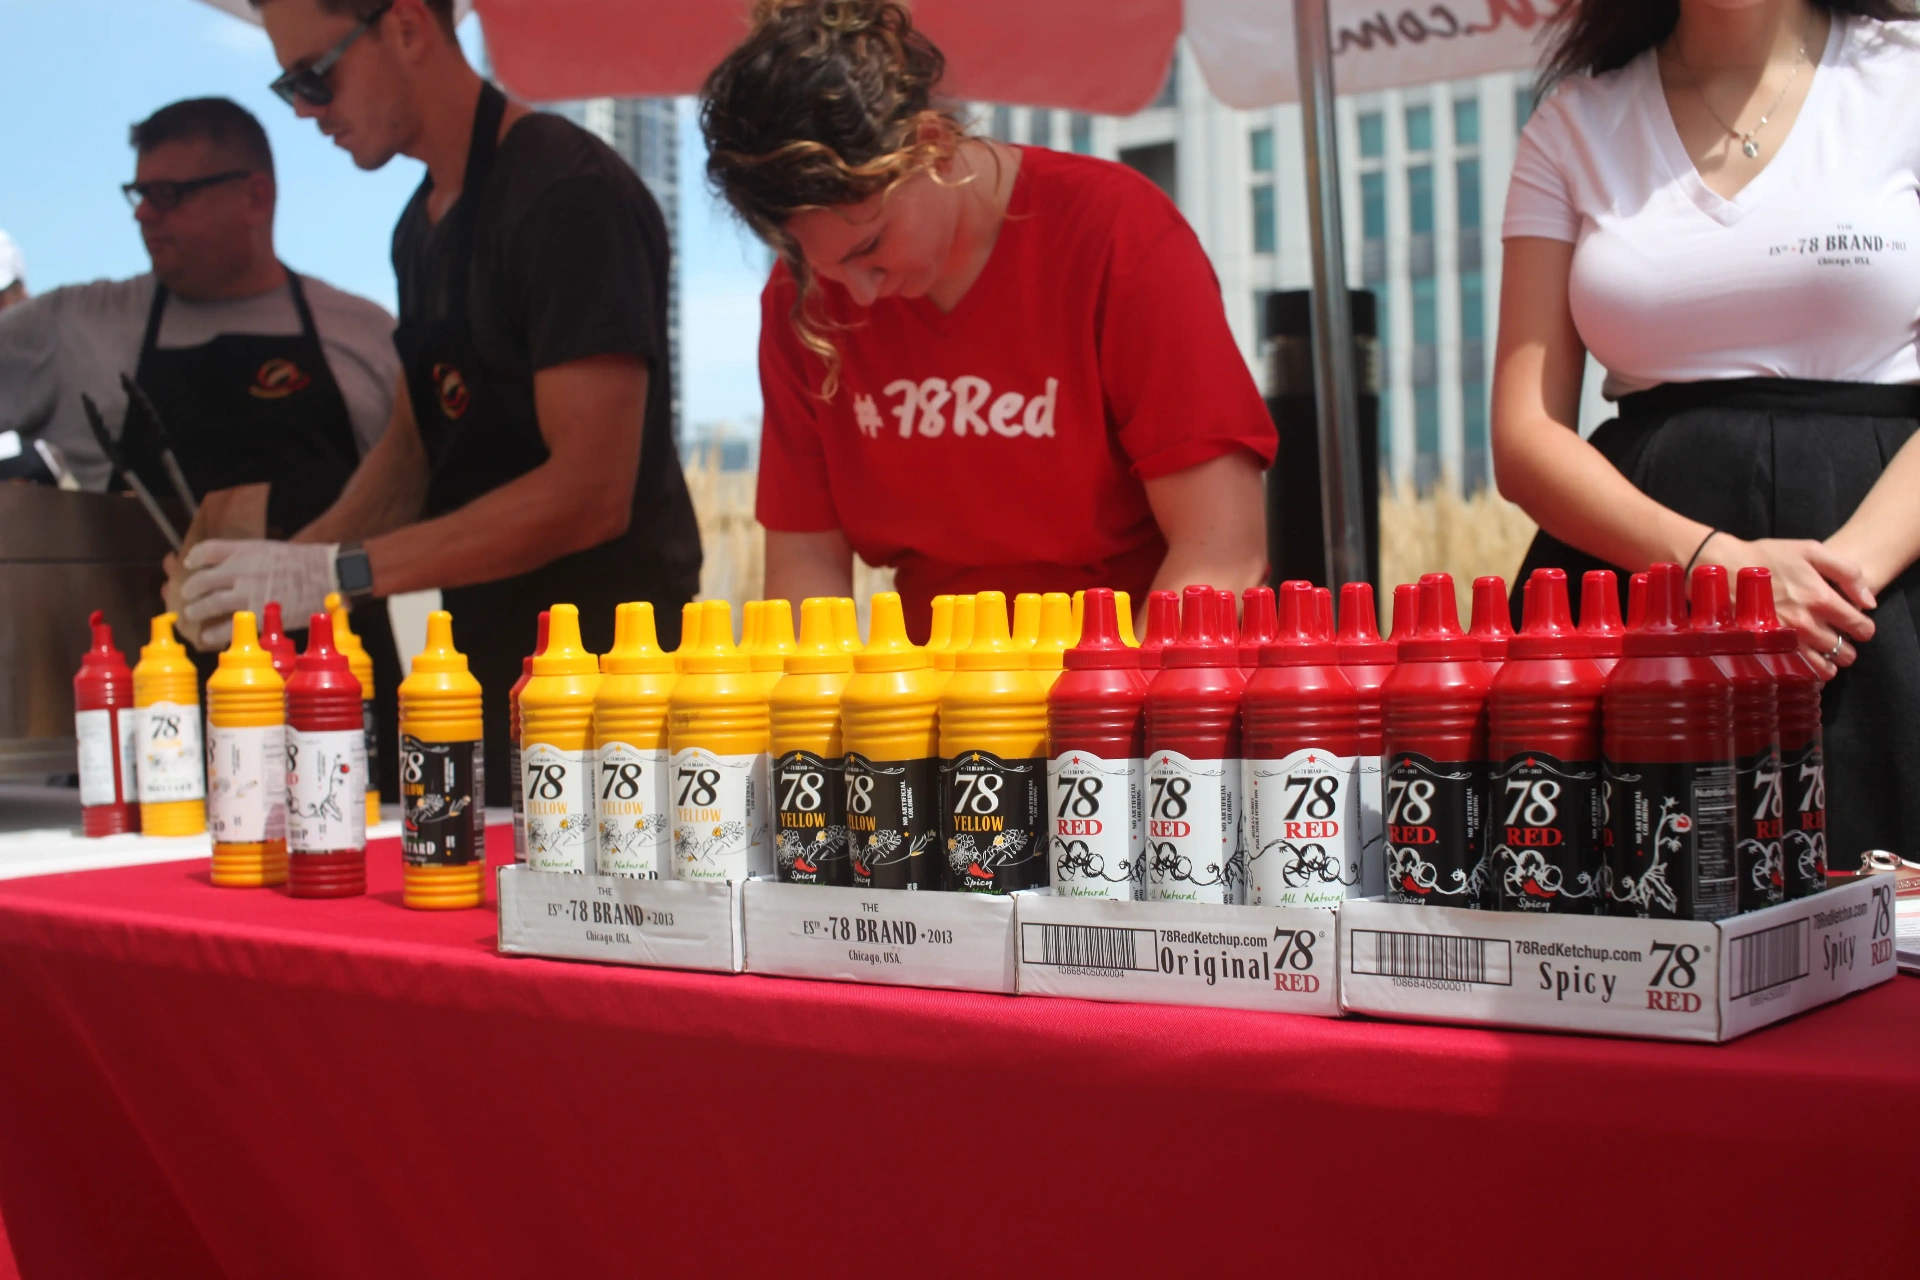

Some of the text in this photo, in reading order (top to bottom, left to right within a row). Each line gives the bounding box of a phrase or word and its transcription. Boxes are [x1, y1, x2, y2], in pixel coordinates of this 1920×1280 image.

[1799, 236, 1819, 255] 78
[1826, 233, 1883, 253] BRAND
[853, 375, 1059, 439] #78Red
[151, 715, 181, 739] 78
[399, 750, 425, 784] 78
[527, 762, 566, 800] 78
[601, 760, 642, 800] 78
[677, 766, 721, 807] 78
[780, 770, 825, 812] 78
[844, 772, 875, 814] 78
[954, 771, 1004, 815] 78
[1056, 774, 1104, 818] 78
[1149, 776, 1192, 820] 78
[1283, 774, 1339, 821] 78
[1387, 776, 1436, 825] 78
[1503, 776, 1561, 827] 78
[528, 801, 568, 815] YELLOW
[602, 801, 644, 815] YELLOW
[899, 779, 909, 826] NO ARTIFICIAL
[906, 787, 914, 819] COLORING
[677, 807, 722, 823] YELLOW
[780, 812, 826, 828] YELLOW
[953, 815, 1005, 832] YELLOW
[1132, 819, 1137, 830] NO
[1634, 790, 1642, 845] NO ARTIFICIAL
[1642, 798, 1650, 836] COLORING
[1057, 819, 1103, 836] RED
[1149, 820, 1191, 838] RED
[1221, 822, 1227, 832] NO
[1284, 820, 1340, 839] RED
[1389, 825, 1437, 845] RED
[1468, 827, 1474, 838] NO
[1505, 826, 1563, 847] RED
[541, 858, 574, 868] Natural
[614, 858, 649, 870] Natural
[690, 868, 728, 878] Natural
[790, 870, 817, 883] Spicy
[963, 877, 993, 890] Spicy
[596, 887, 613, 896] THE
[1070, 886, 1111, 897] Natural
[1159, 889, 1198, 901] Natural
[1280, 890, 1345, 904] All Natural
[1397, 893, 1426, 906] Spicy
[569, 899, 588, 922] 78
[592, 901, 645, 926] BRAND
[651, 911, 675, 926] 2013
[861, 902, 880, 913] THE
[1517, 897, 1551, 913] Spicy
[1871, 884, 1891, 940] 78
[585, 930, 632, 946] Chicago, USA.
[828, 916, 851, 941] 78
[855, 918, 917, 945] BRAND
[927, 929, 953, 944] 2013
[1159, 929, 1268, 949] 78RedKetchup.com
[848, 949, 903, 965] Chicago, USA.
[1273, 926, 1316, 971] 78
[1514, 940, 1643, 963] 78RedKetchup.com
[1822, 931, 1857, 981] Spicy
[1871, 937, 1892, 966] RED
[1160, 946, 1270, 986] Original
[1647, 939, 1701, 989] 78
[1273, 972, 1320, 993] RED
[1391, 977, 1473, 993] 10868405000011
[1538, 961, 1617, 1003] Spicy
[1645, 989, 1702, 1013] RED
